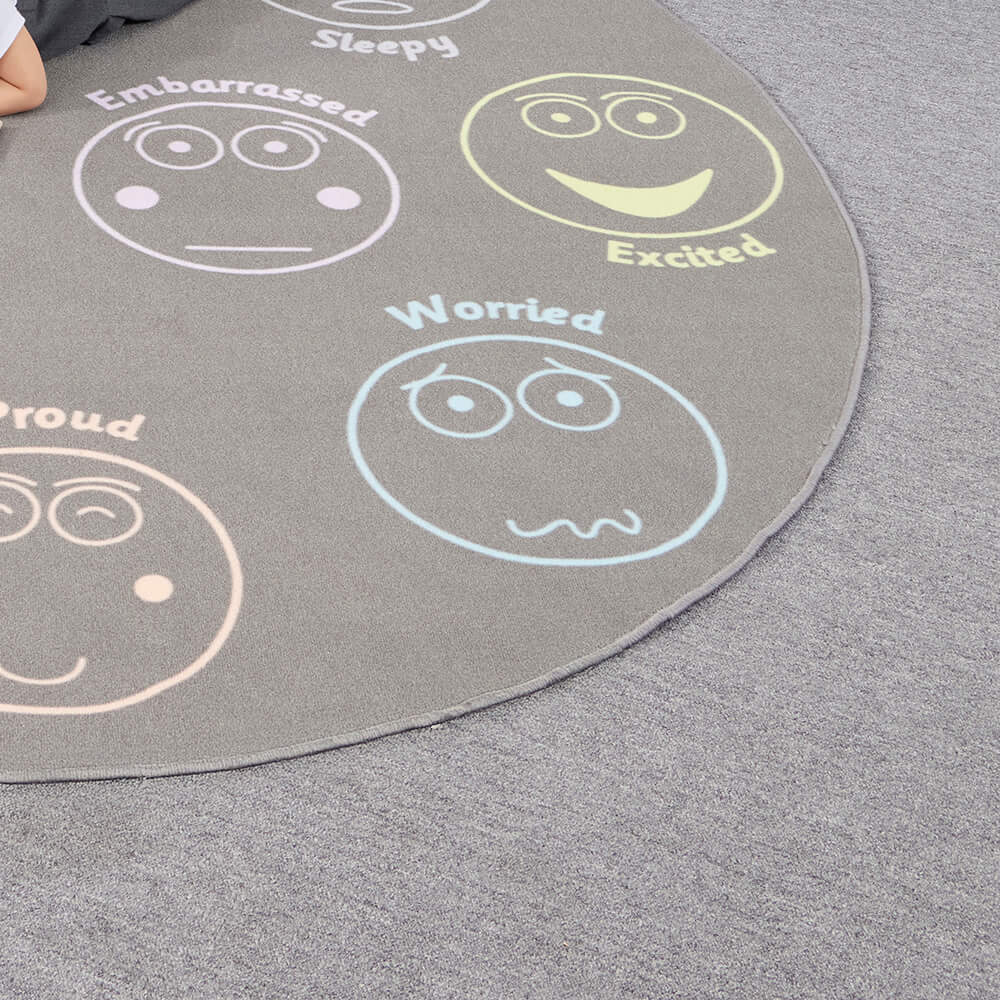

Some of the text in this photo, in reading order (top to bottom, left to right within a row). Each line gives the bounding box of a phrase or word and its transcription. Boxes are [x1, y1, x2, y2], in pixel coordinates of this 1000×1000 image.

[310, 27, 461, 62] Sleepy
[84, 76, 379, 128] Embarrassed
[606, 232, 777, 268] Excited
[383, 293, 607, 335] Worried
